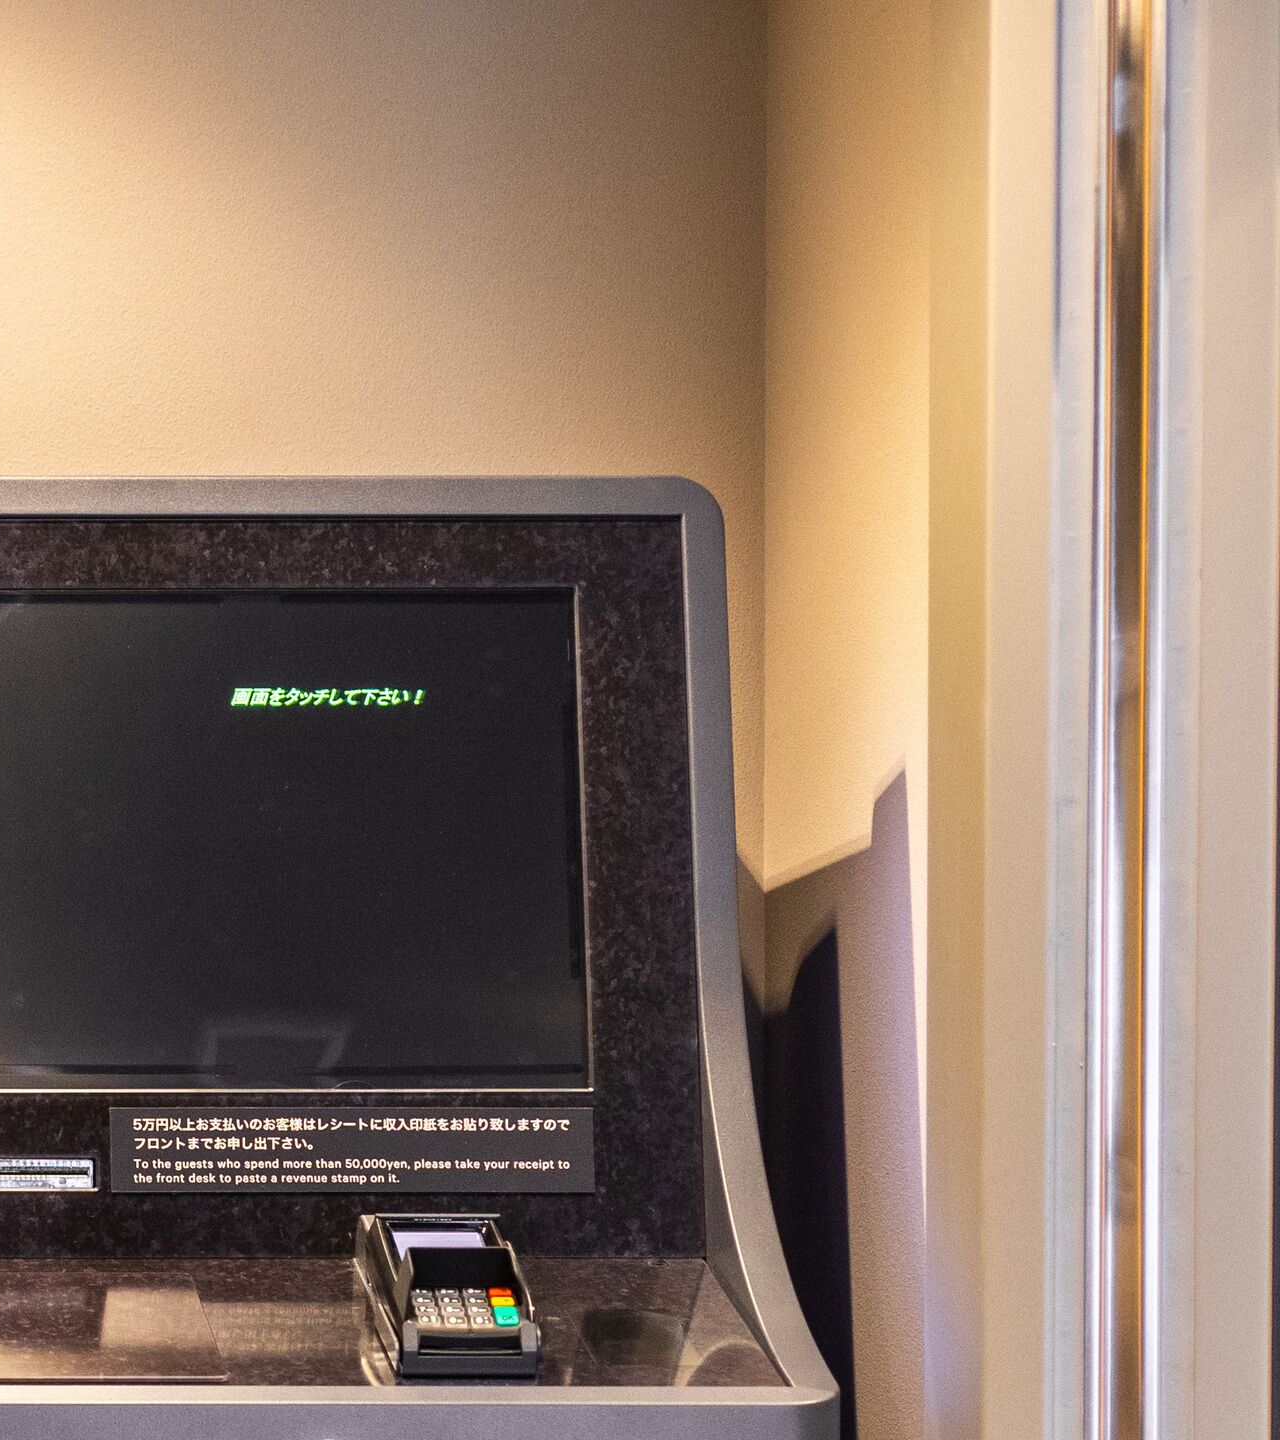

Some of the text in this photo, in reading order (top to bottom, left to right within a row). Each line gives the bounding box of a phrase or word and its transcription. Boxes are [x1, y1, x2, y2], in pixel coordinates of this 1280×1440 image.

[229, 686, 425, 707] 画面をタッチして下さい！
[132, 1117, 571, 1132] 5万円以上お支払いのお客様はレシートに収入印紙をお貼り致しますので
[133, 1136, 314, 1151] フロントまでお申し出下さい。
[132, 1158, 571, 1172] To the guests who spend more than 50,000yen, please take your receipt to
[133, 1172, 401, 1186] the front desk to paste a revenue stamp on it.
